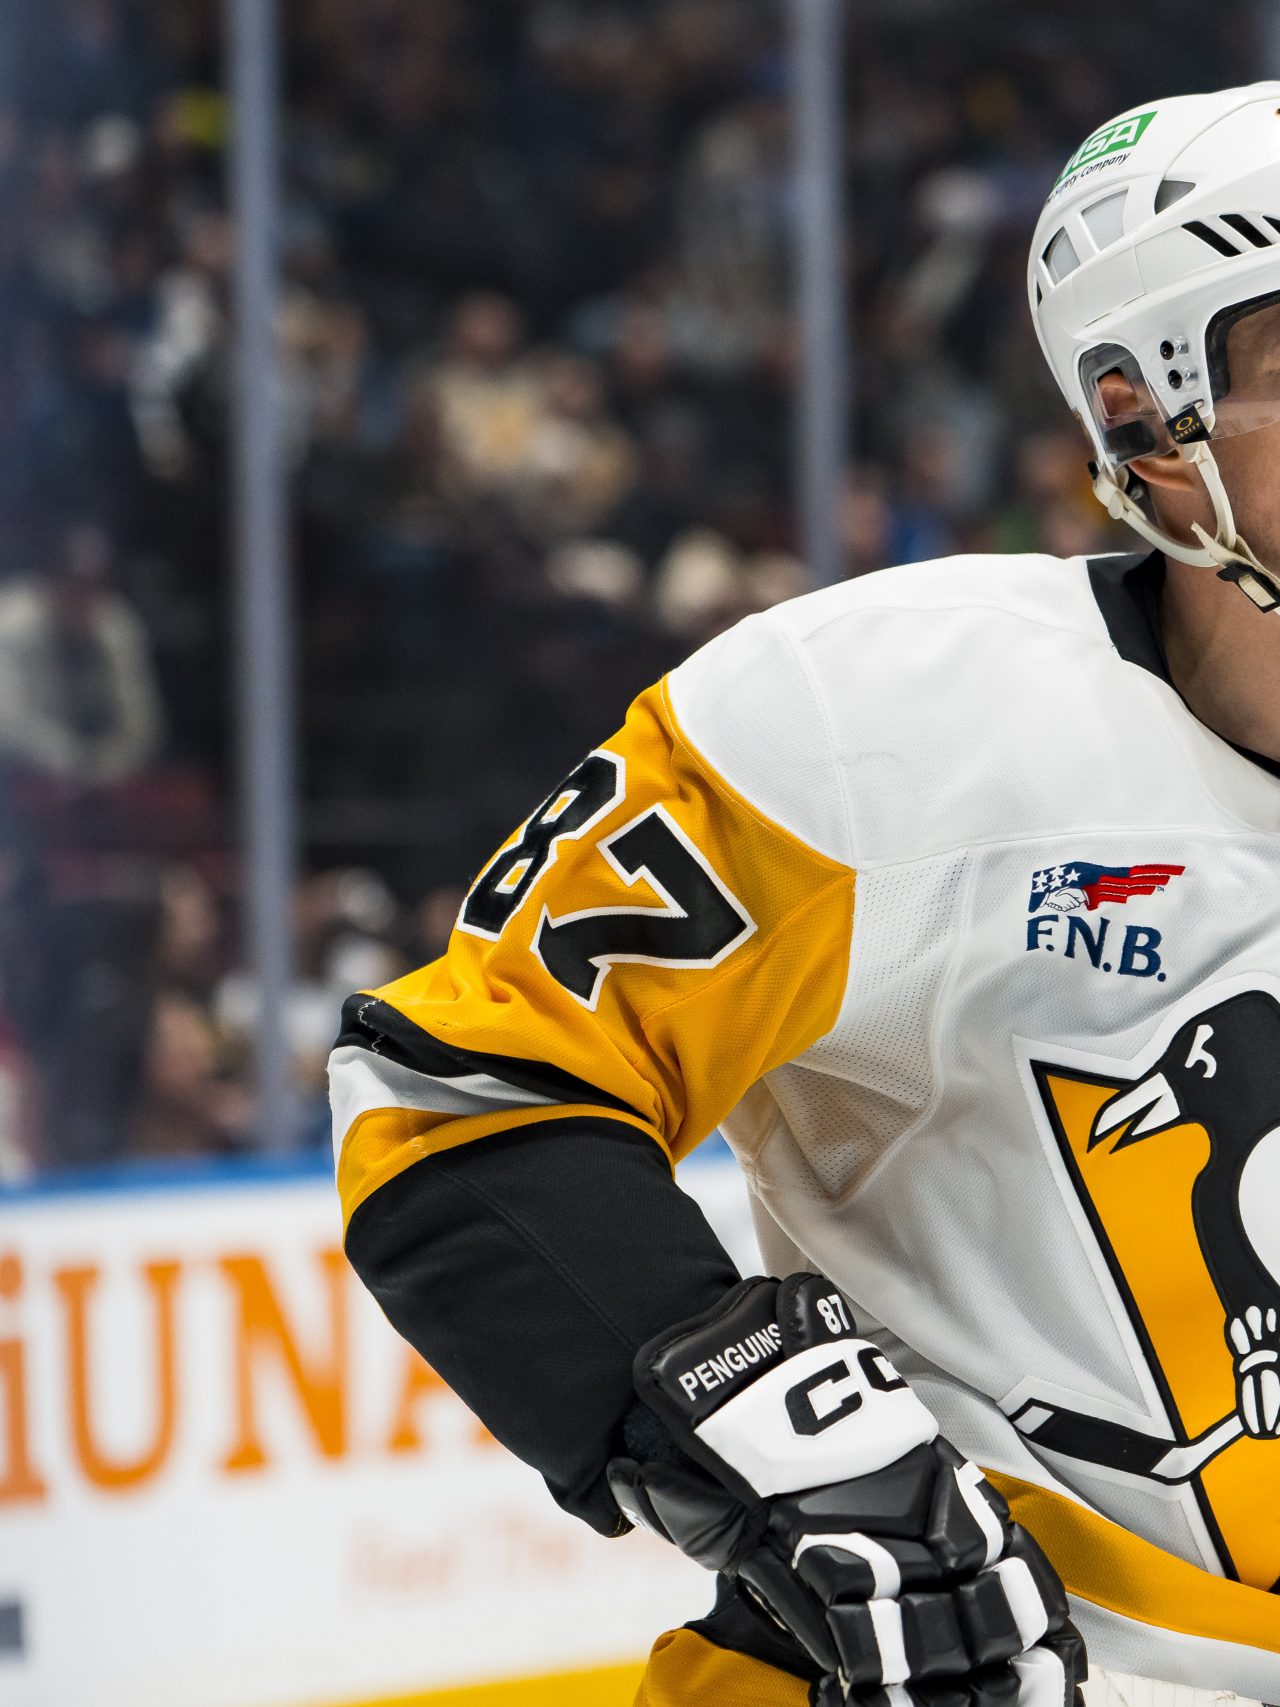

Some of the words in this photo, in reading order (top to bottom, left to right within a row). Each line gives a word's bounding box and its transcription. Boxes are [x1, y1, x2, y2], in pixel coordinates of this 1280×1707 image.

[1080, 152, 1132, 178] Company
[456, 748, 759, 1013] 87
[1026, 914, 1167, 983] F.N.B.
[816, 1294, 851, 1336] 87
[678, 1322, 783, 1402] PENGUINS
